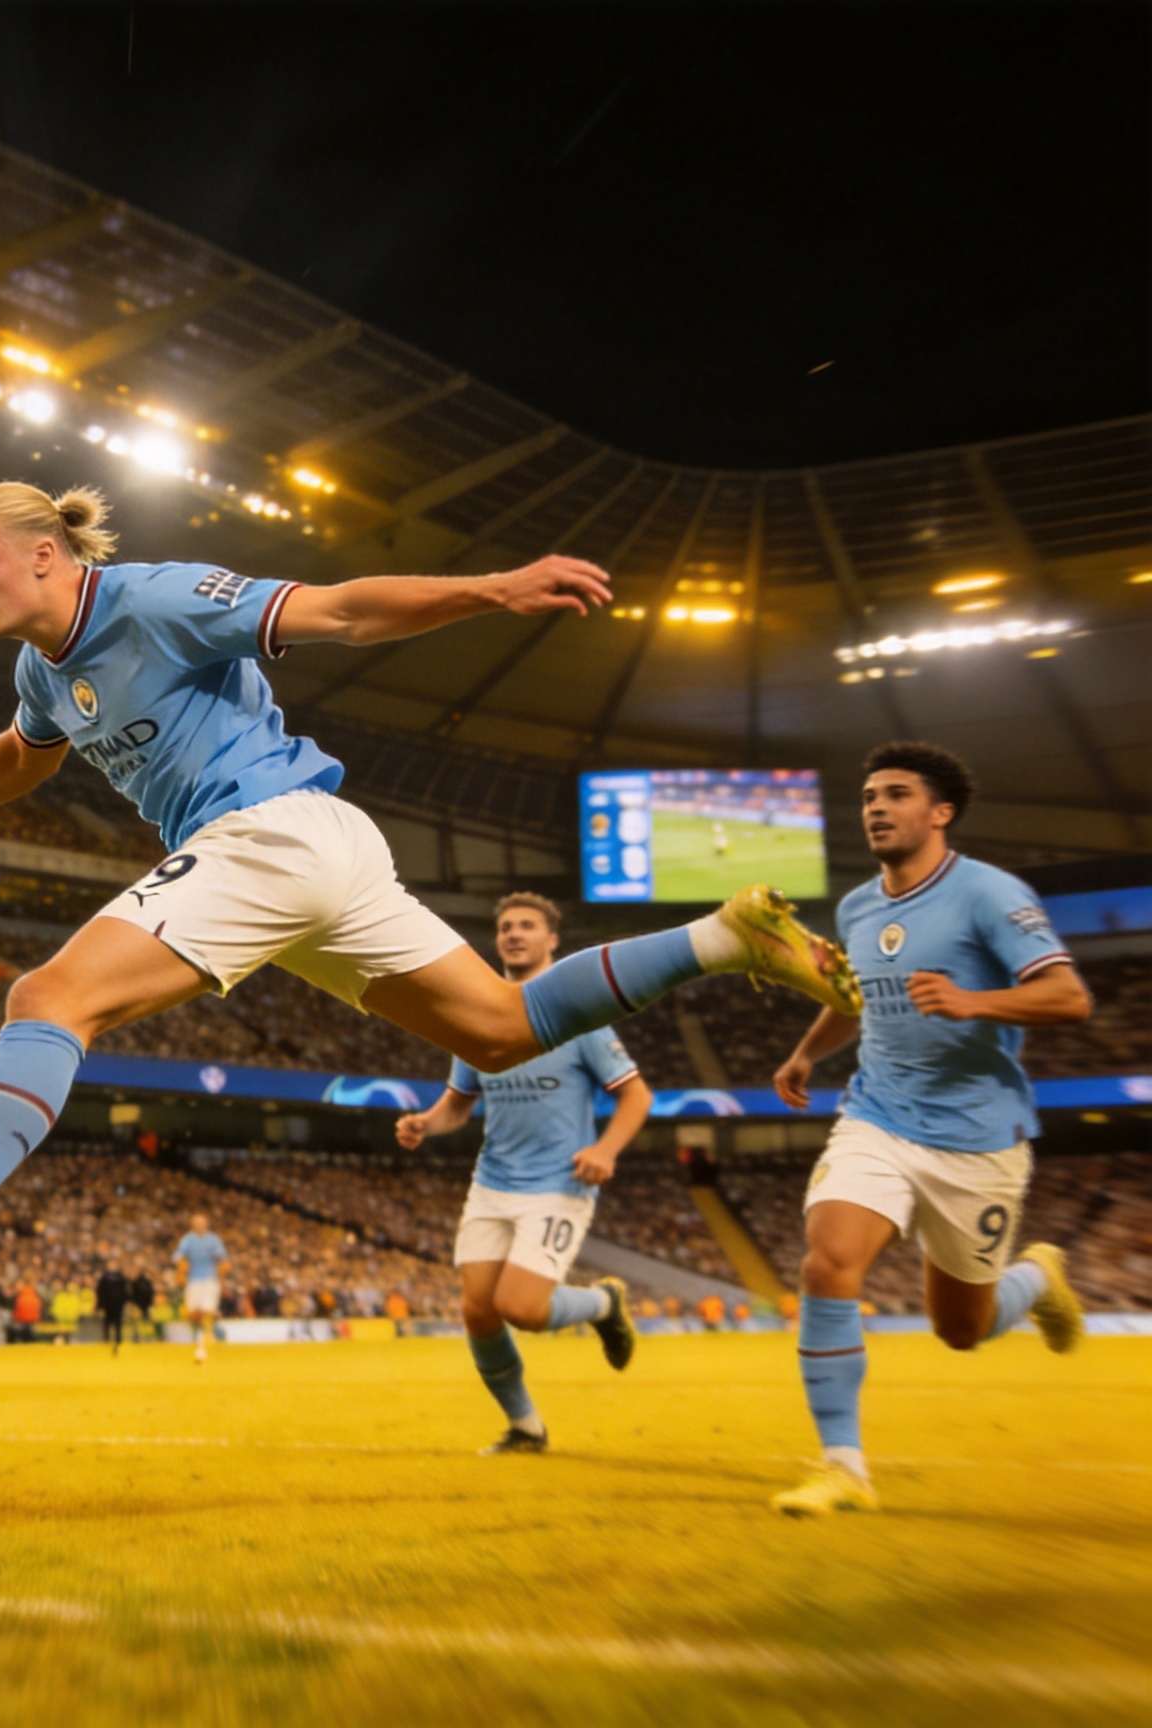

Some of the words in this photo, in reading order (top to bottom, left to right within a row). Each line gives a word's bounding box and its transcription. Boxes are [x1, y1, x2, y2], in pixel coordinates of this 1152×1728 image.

[145, 853, 198, 889] 9
[541, 1215, 574, 1254] 10
[976, 1204, 1009, 1254] 9
